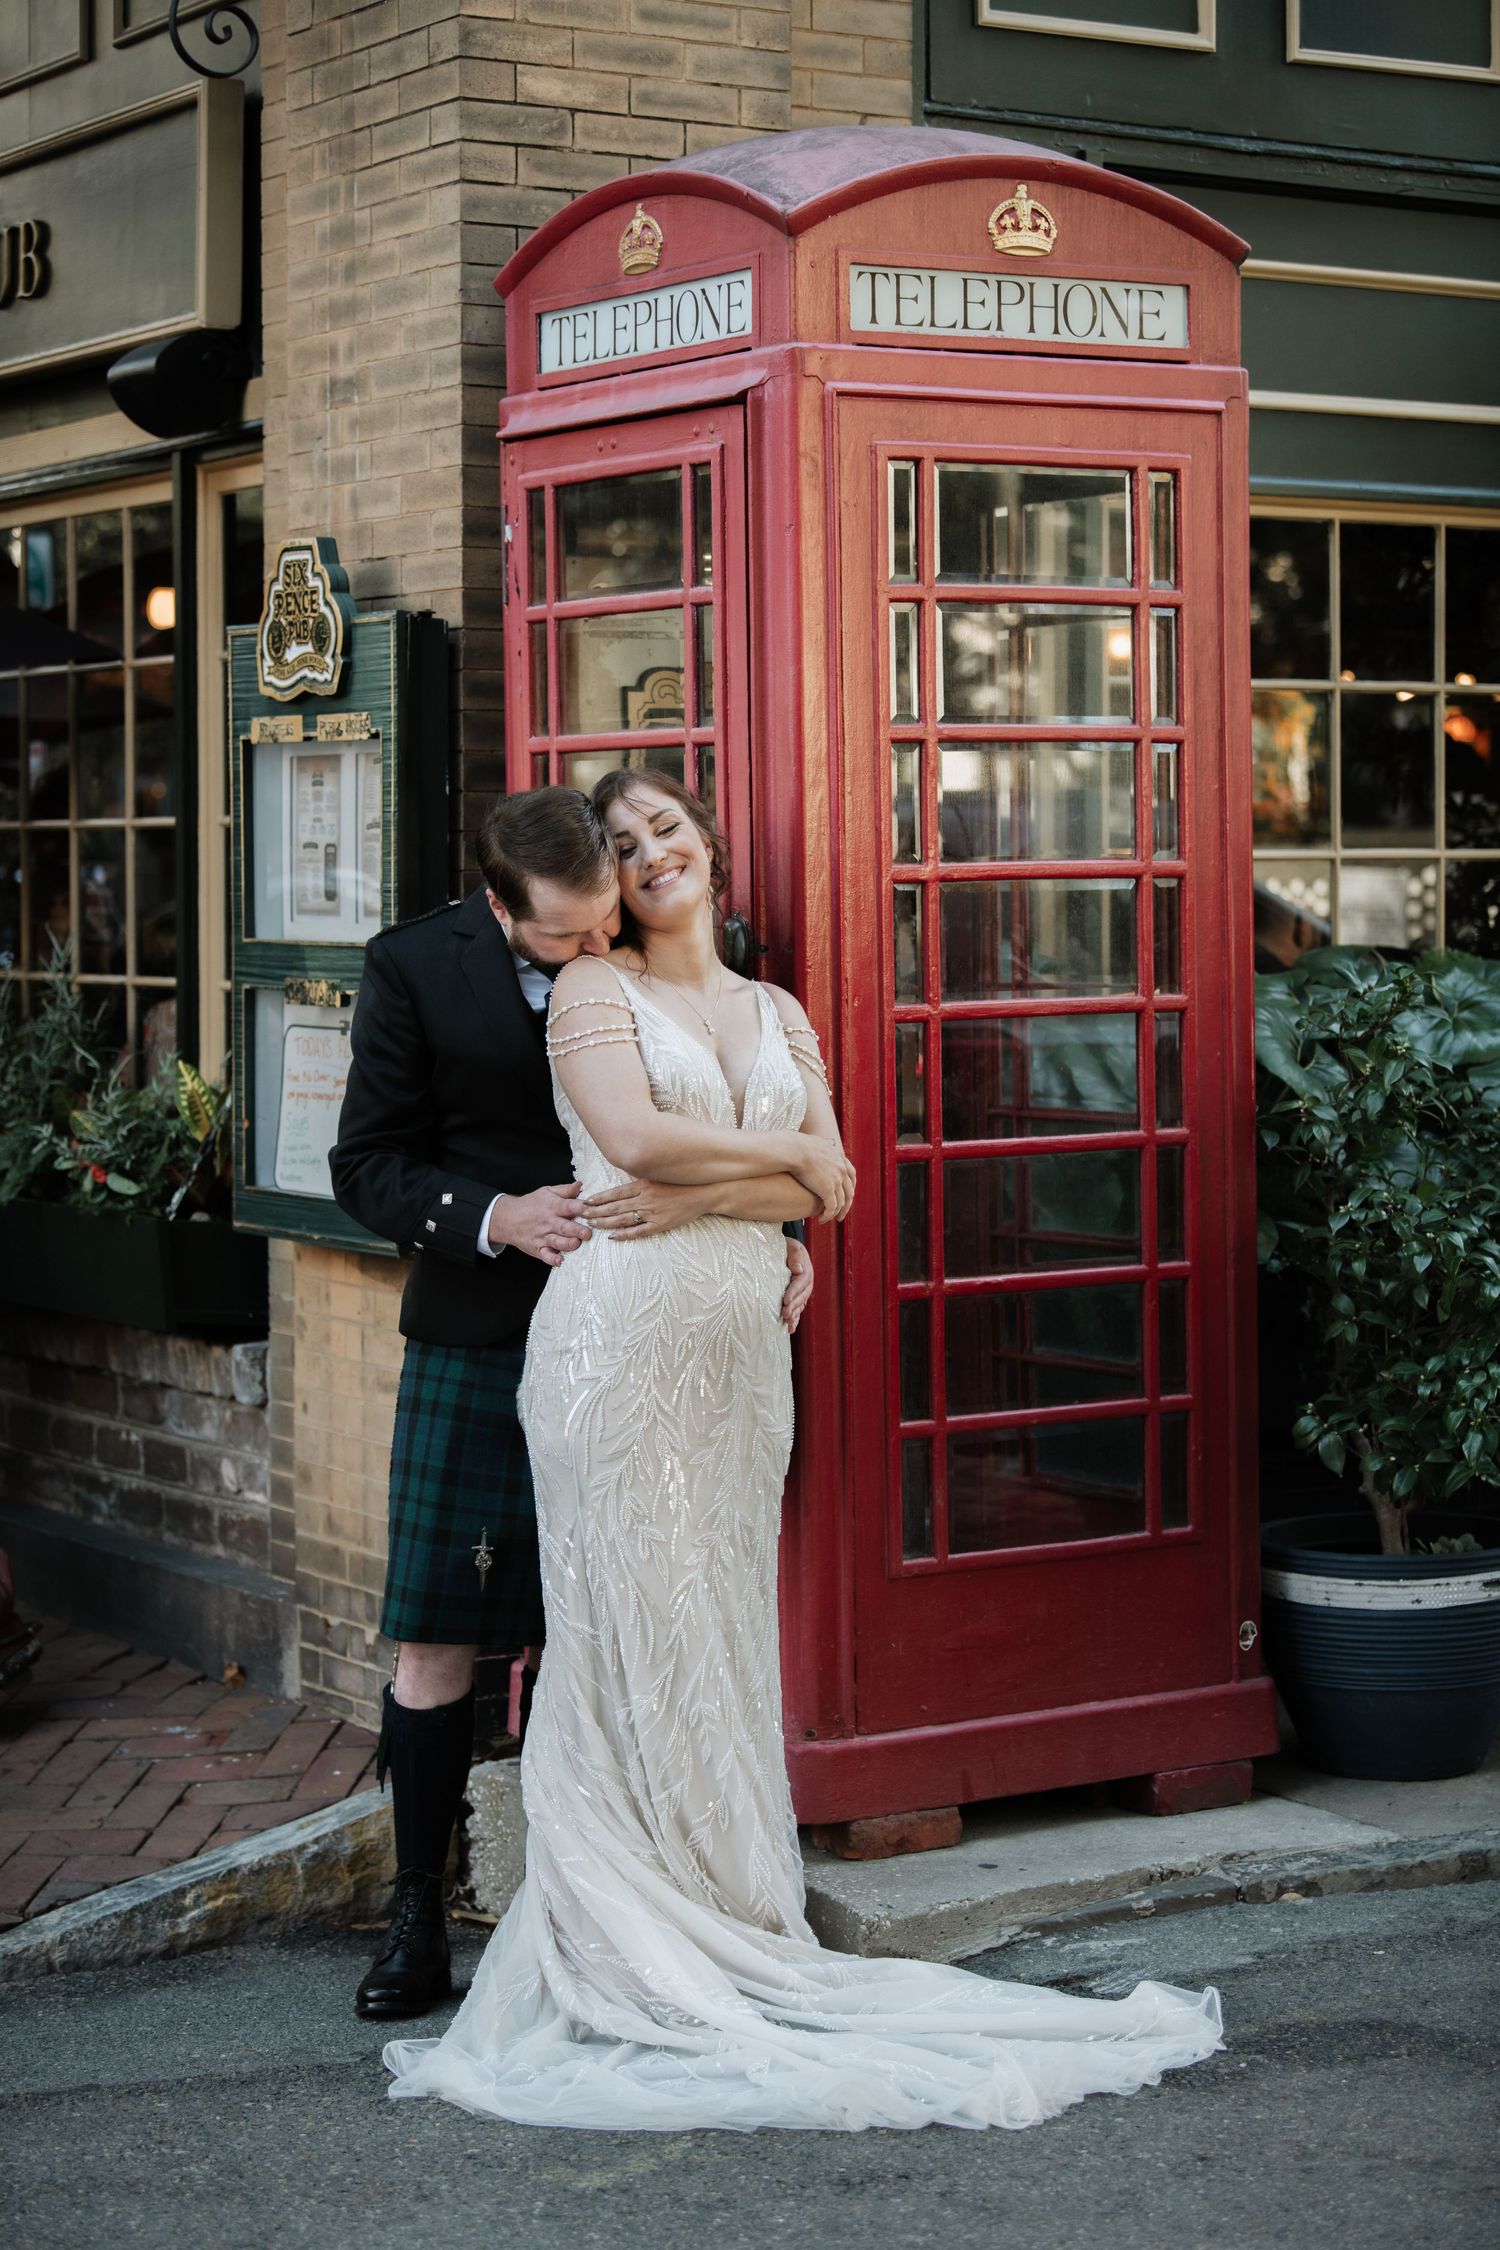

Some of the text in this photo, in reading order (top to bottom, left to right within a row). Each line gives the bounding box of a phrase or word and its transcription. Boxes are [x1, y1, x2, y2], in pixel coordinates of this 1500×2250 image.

[855, 270, 1166, 341] TELEPHONE
[551, 279, 746, 367] TELEPHONE
[284, 562, 308, 587] SIX
[274, 589, 319, 619] PENCE
[287, 618, 310, 645] PUB
